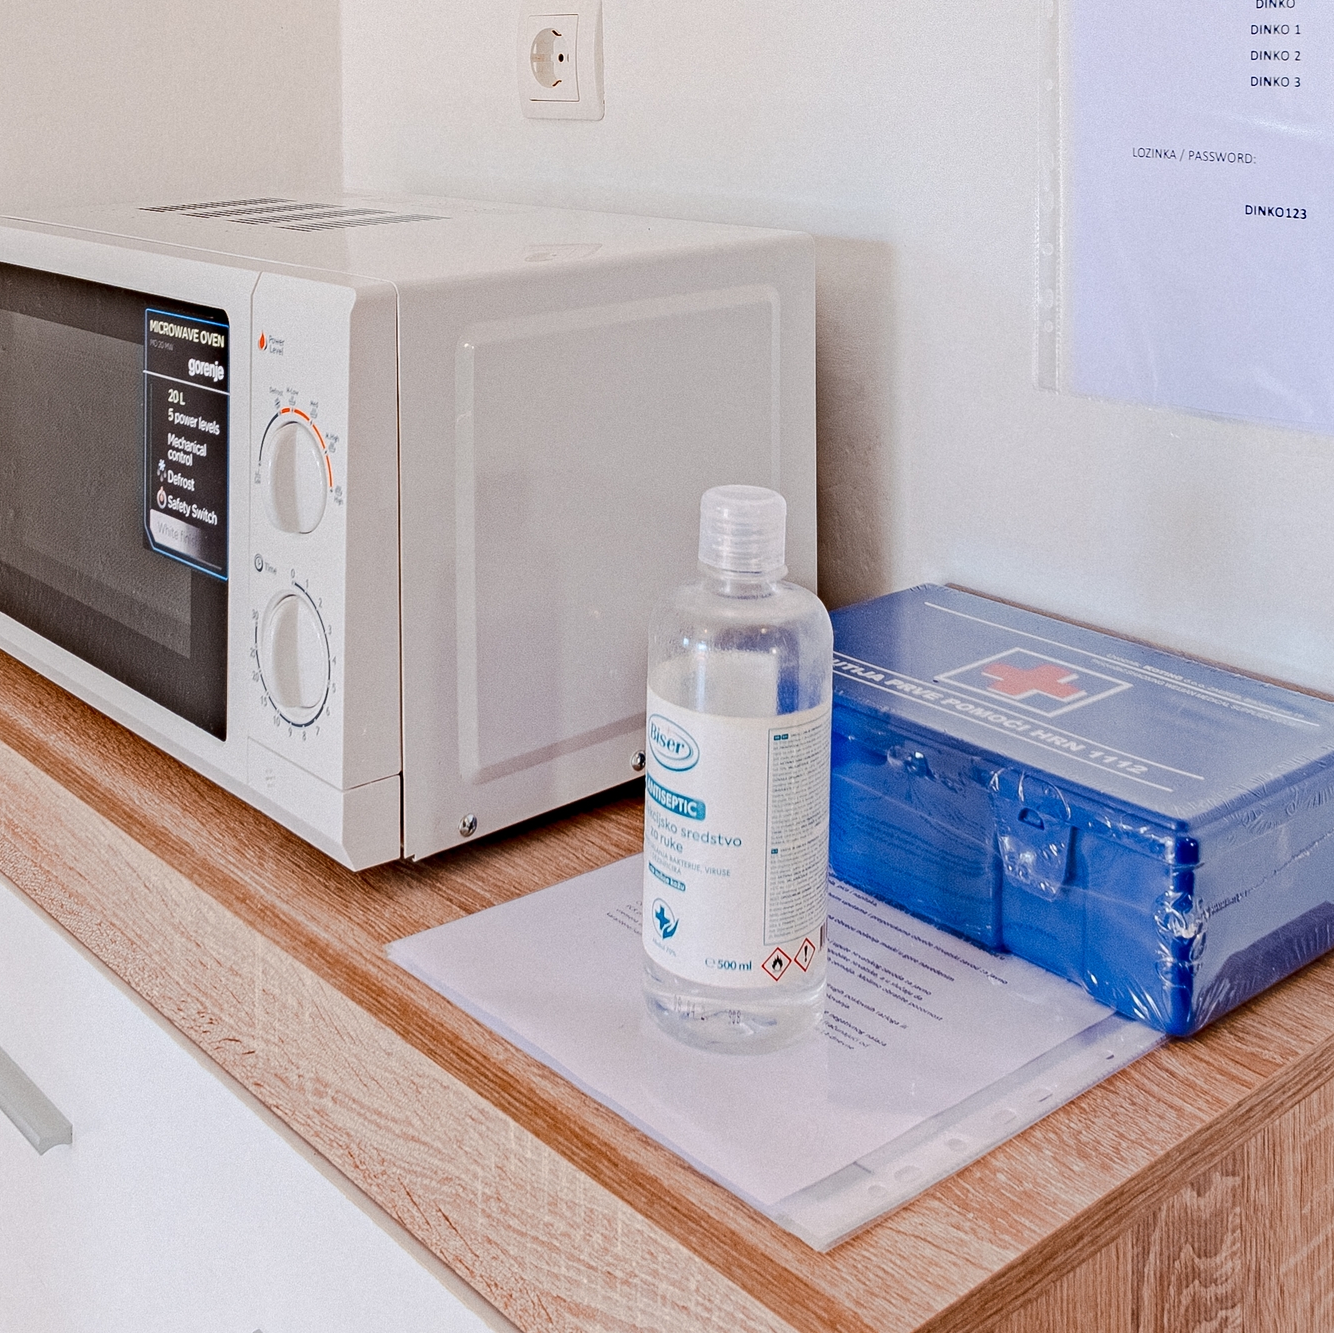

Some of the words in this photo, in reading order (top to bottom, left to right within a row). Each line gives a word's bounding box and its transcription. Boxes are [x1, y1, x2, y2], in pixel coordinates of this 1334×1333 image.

[1250, 24, 1290, 35] DINKO
[1295, 24, 1301, 35] 1
[1250, 50, 1290, 61] DINKO
[1294, 50, 1302, 61] 2
[1250, 76, 1290, 87] DINKO
[1294, 76, 1301, 88] 3
[1132, 147, 1177, 160] LOZINKA
[1188, 150, 1257, 165] PASSWORD:
[1245, 204, 1308, 220] DINKO123
[149, 319, 200, 343] MICROWAVE
[200, 330, 225, 348] OVEN
[268, 334, 285, 347] Power
[269, 345, 284, 356] Level
[188, 358, 225, 383] gorenje
[167, 388, 179, 404] 20
[179, 392, 186, 405] L
[167, 407, 174, 421] 5
[174, 412, 198, 429] power
[198, 416, 220, 436] levels
[167, 432, 207, 457] Mechanical
[167, 449, 193, 467] control
[167, 469, 195, 492] Defrost
[167, 495, 191, 518] Safety
[191, 504, 218, 526] Switch
[157, 521, 179, 541] White
[264, 562, 278, 575] Time
[833, 659, 885, 682] UTIJA
[884, 679, 945, 701] PRVE
[1030, 729, 1086, 752] HRN
[1088, 750, 1149, 775] 1112
[650, 722, 685, 754] Biser
[660, 834, 684, 854] ruke
[680, 827, 742, 847] sredstvo
[705, 865, 731, 877] VIRUSE
[717, 959, 737, 970] 500
[738, 960, 752, 971] ml
